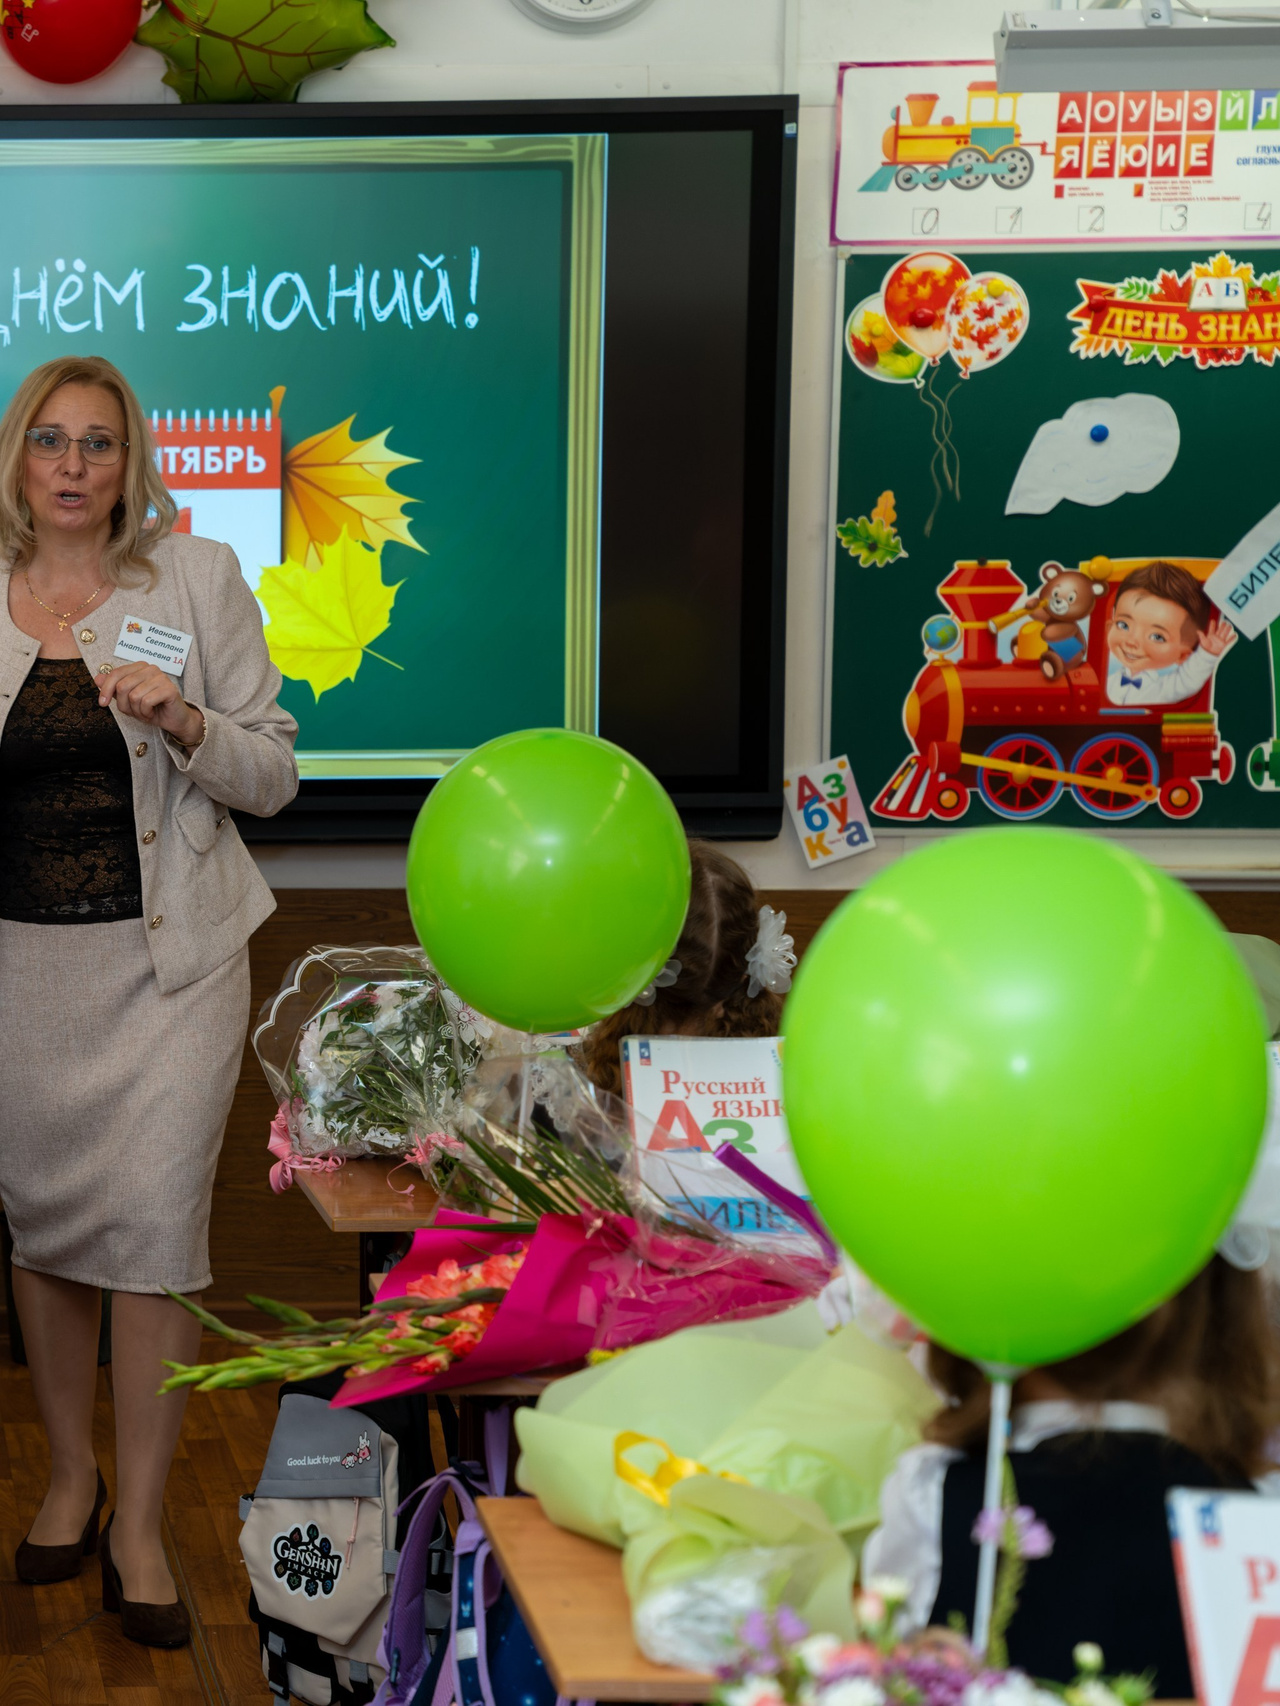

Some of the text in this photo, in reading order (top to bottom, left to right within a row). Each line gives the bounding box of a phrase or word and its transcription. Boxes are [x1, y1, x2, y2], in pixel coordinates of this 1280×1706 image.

[1060, 91, 1278, 123] А О У Ы Э Й Л
[1059, 140, 1208, 169] Я Ё Ю И Е
[1089, 205, 1105, 233] 2
[1170, 204, 1188, 232] 3
[1256, 201, 1272, 230] 4
[175, 246, 481, 333] знаний!
[1197, 282, 1240, 298] А Б
[1098, 306, 1189, 341] ДЕНЬ
[154, 445, 267, 475] ТЯБРЬ
[145, 636, 185, 654] Светлана
[147, 625, 183, 642] Иванова
[117, 639, 184, 666] Анатольевна 1А
[660, 1069, 766, 1100] Русский
[646, 1099, 758, 1154] АЗ
[286, 1455, 307, 1466] Good
[307, 1454, 322, 1465] luck
[329, 1455, 341, 1466] you
[276, 1539, 340, 1576] GENSHIN
[286, 1560, 326, 1579] IMPACT
